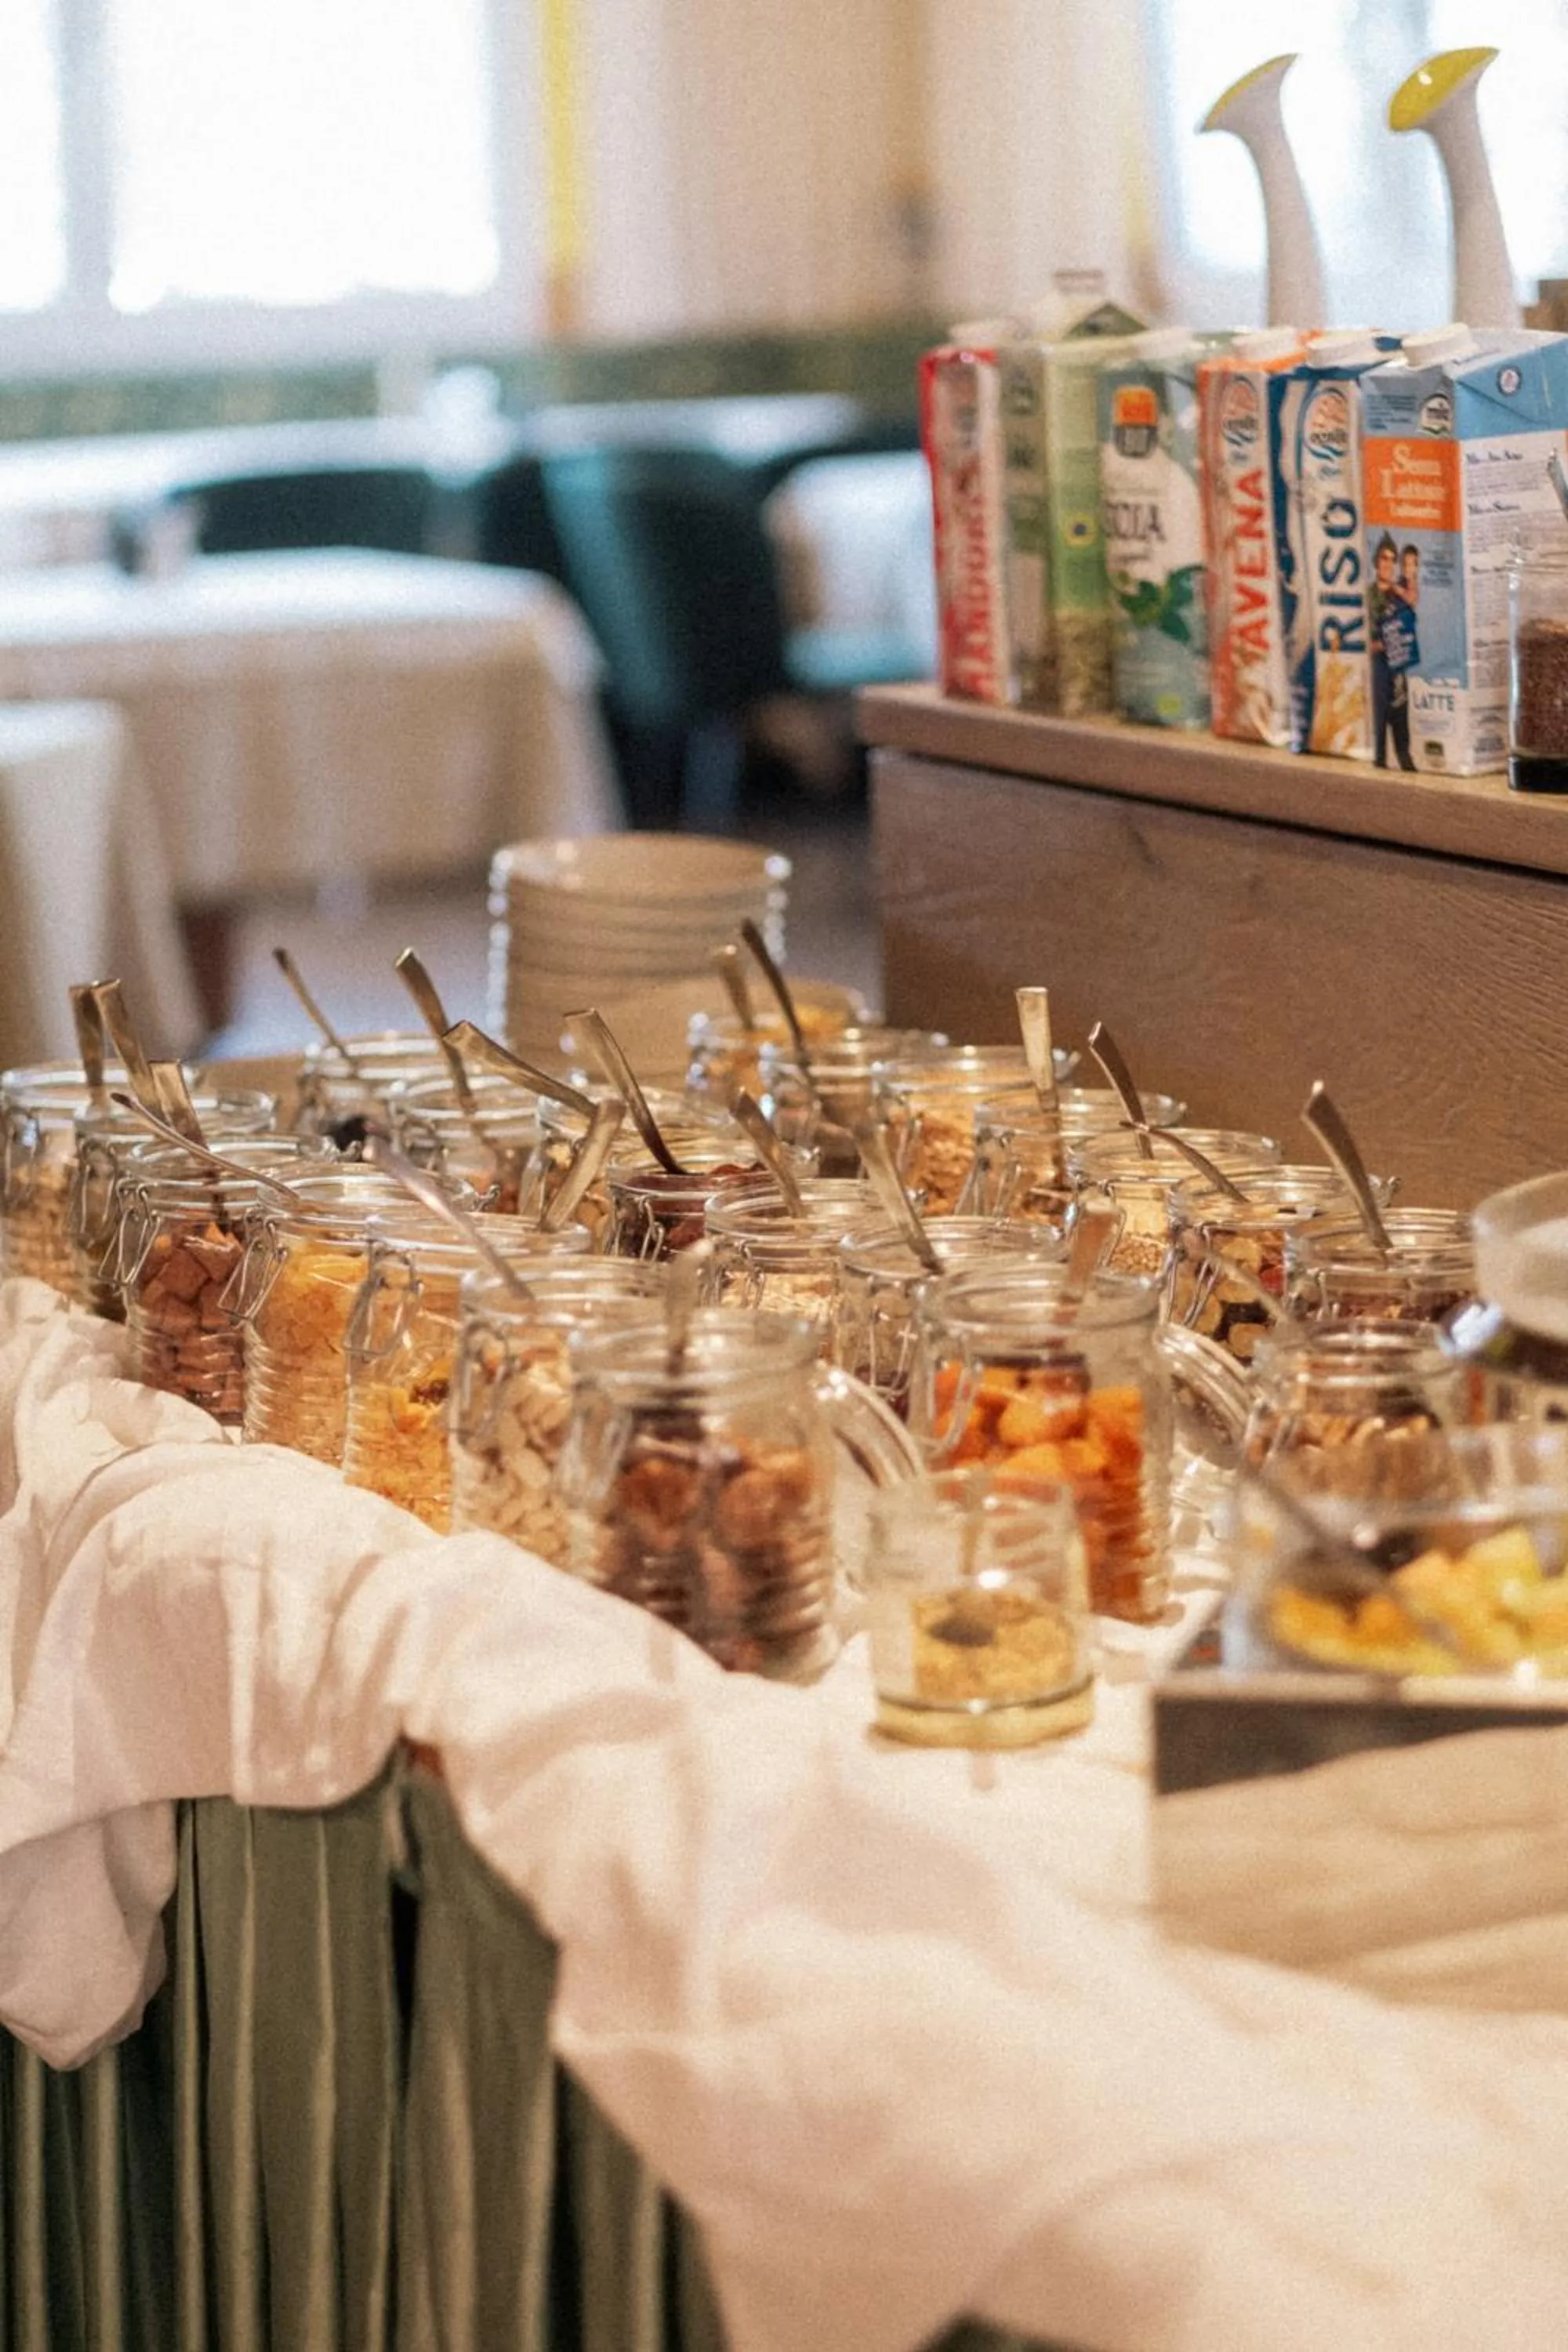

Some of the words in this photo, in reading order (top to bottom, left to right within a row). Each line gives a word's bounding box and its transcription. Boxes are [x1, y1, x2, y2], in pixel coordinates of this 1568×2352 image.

[1233, 470, 1270, 652] AVENA
[1318, 498, 1366, 653] RISO
[1412, 690, 1454, 712] LATTE
